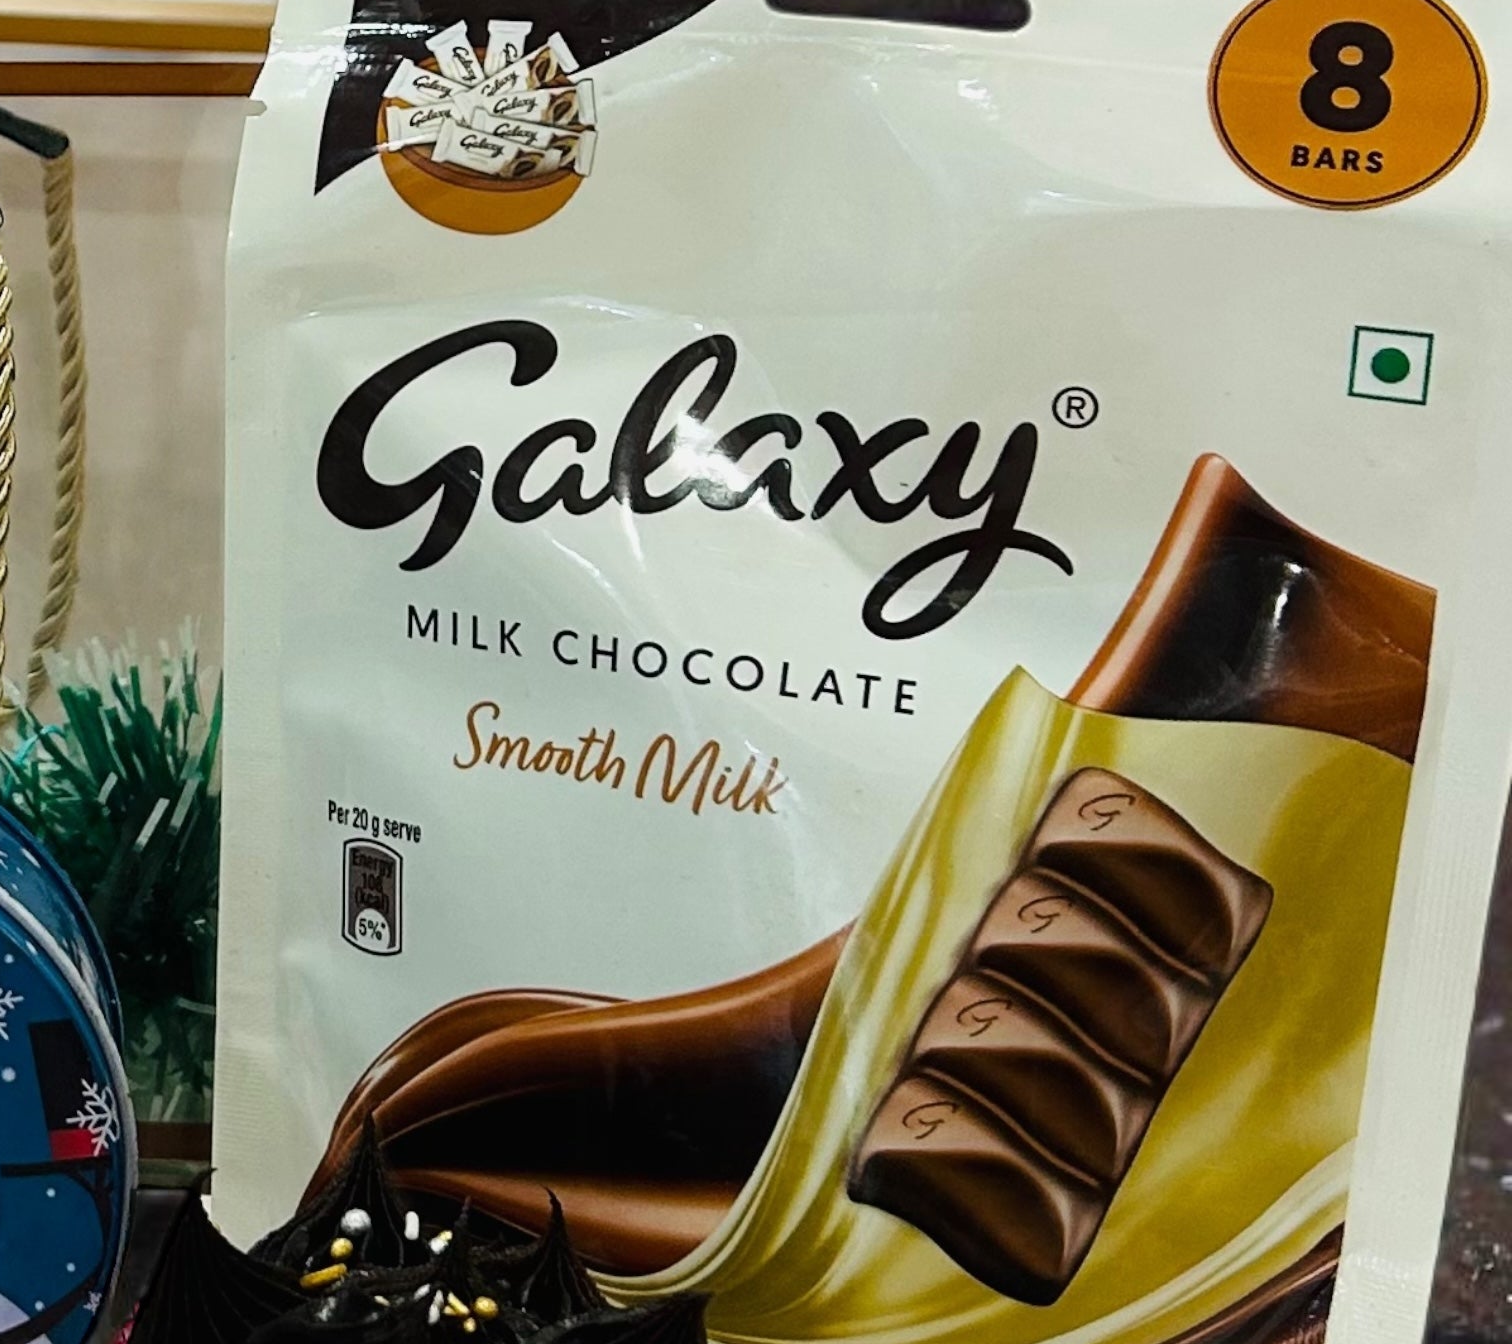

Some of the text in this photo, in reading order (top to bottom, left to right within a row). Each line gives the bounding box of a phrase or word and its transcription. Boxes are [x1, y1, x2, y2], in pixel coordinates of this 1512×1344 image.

[1299, 19, 1395, 133] 8
[492, 96, 538, 116] Galaxy
[459, 134, 506, 158] Galaxy
[492, 122, 538, 145] Galaxy
[1290, 144, 1385, 174] BARS
[316, 319, 1074, 641] Galaxy
[406, 604, 918, 716] MILK CHOCOLATE
[452, 700, 790, 816] Smooth Milk
[328, 799, 423, 844] Per 20 g serve
